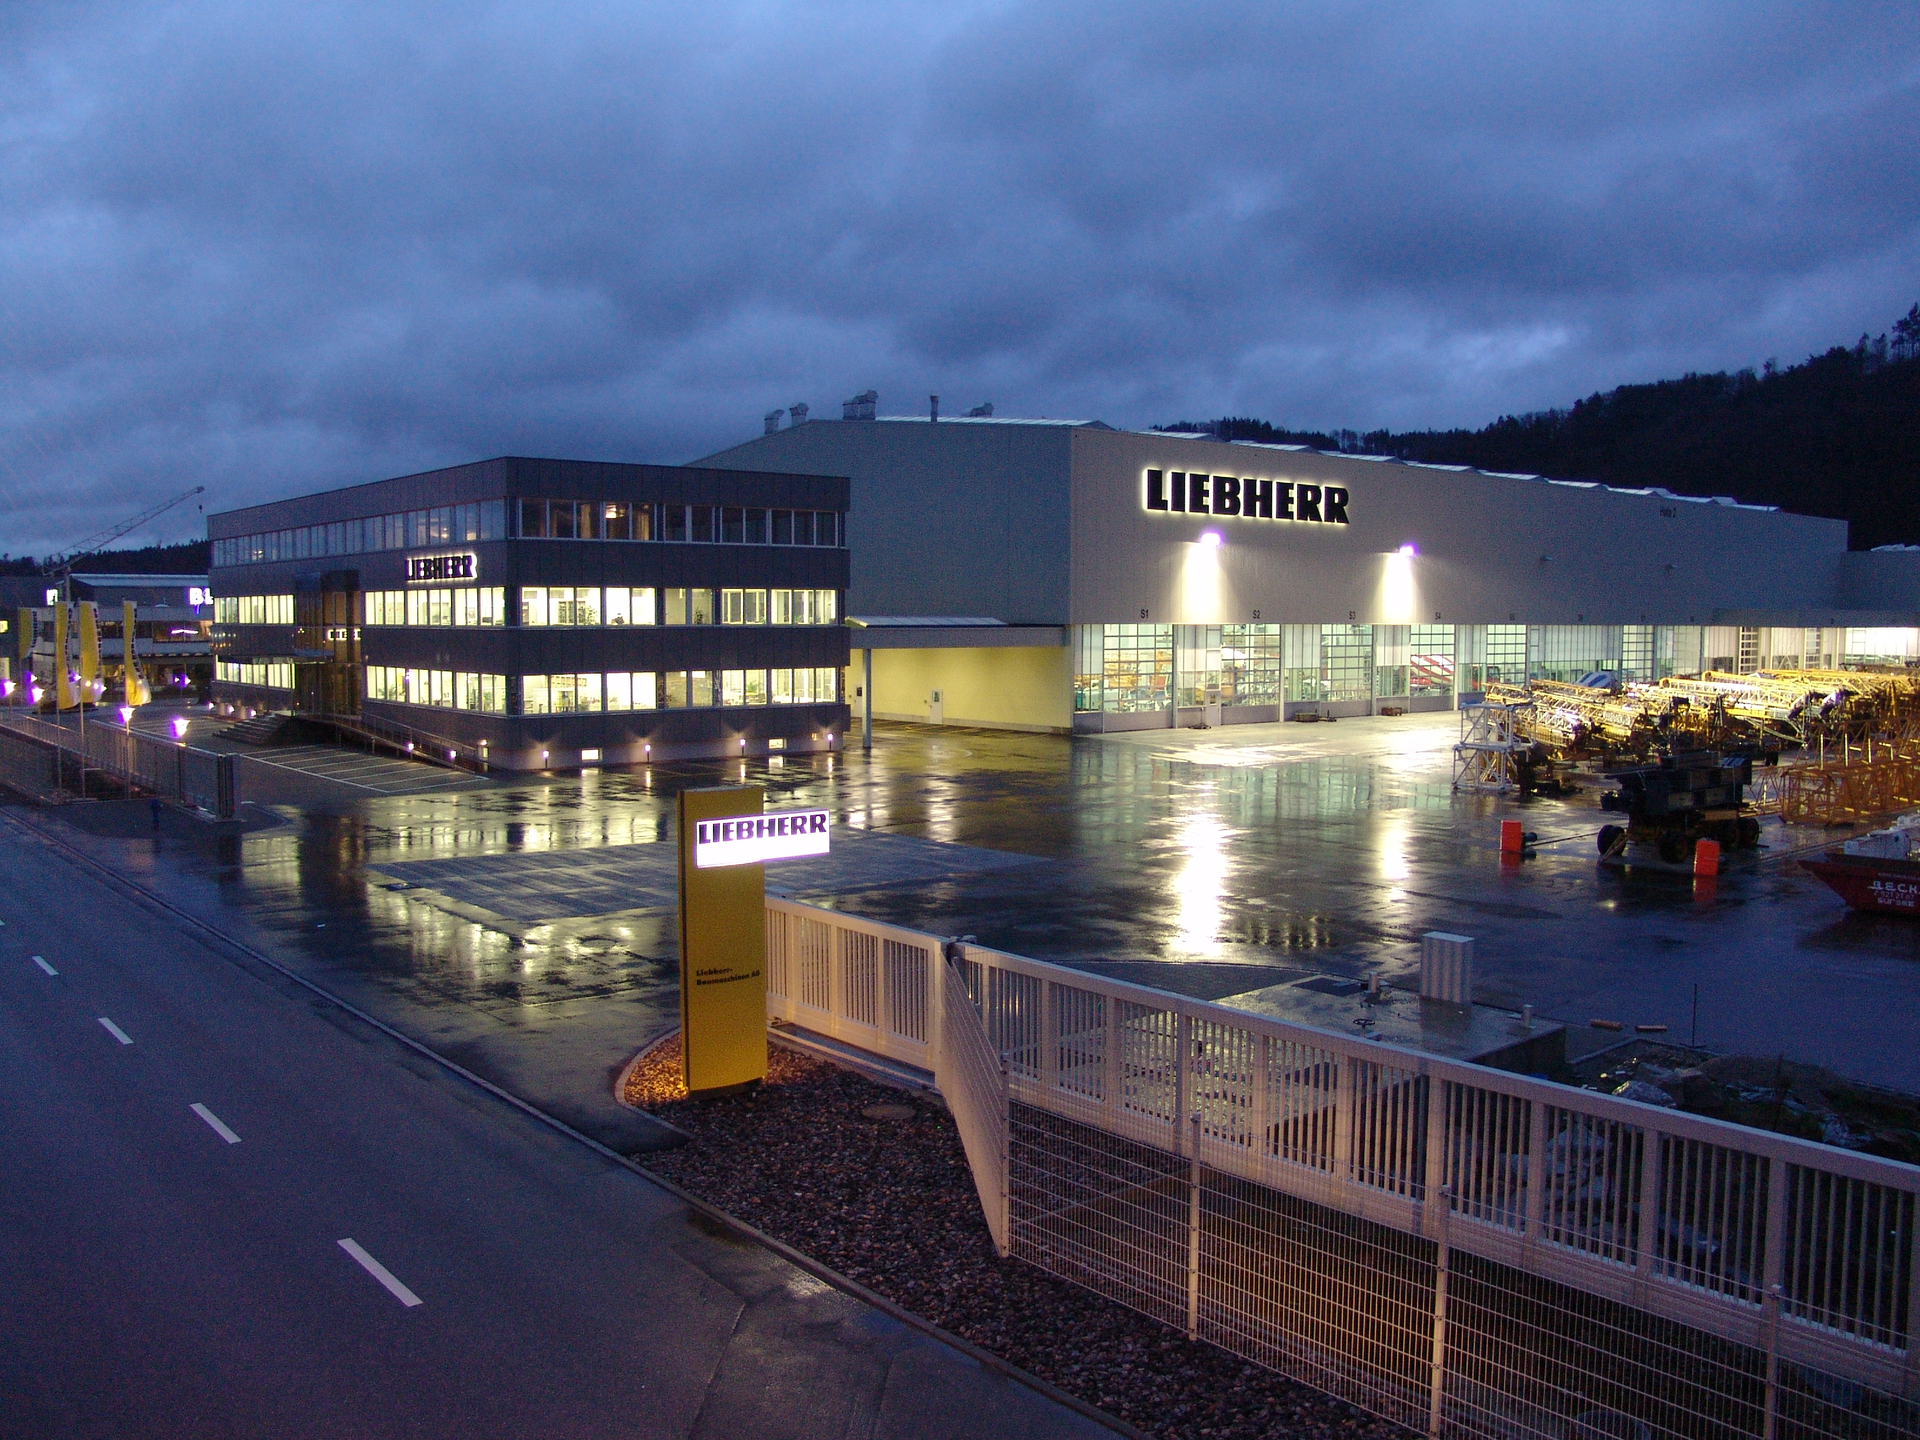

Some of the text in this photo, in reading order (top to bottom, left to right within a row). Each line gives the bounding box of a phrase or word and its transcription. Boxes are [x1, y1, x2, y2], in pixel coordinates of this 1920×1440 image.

[1145, 468, 1349, 524] LIEBHERR
[405, 555, 475, 581] LIEBHERR
[1140, 609, 1149, 619] S1
[1252, 609, 1261, 620] S2
[1348, 610, 1356, 620] S3
[698, 813, 827, 845] LIEBHERR
[751, 969, 760, 977] AG
